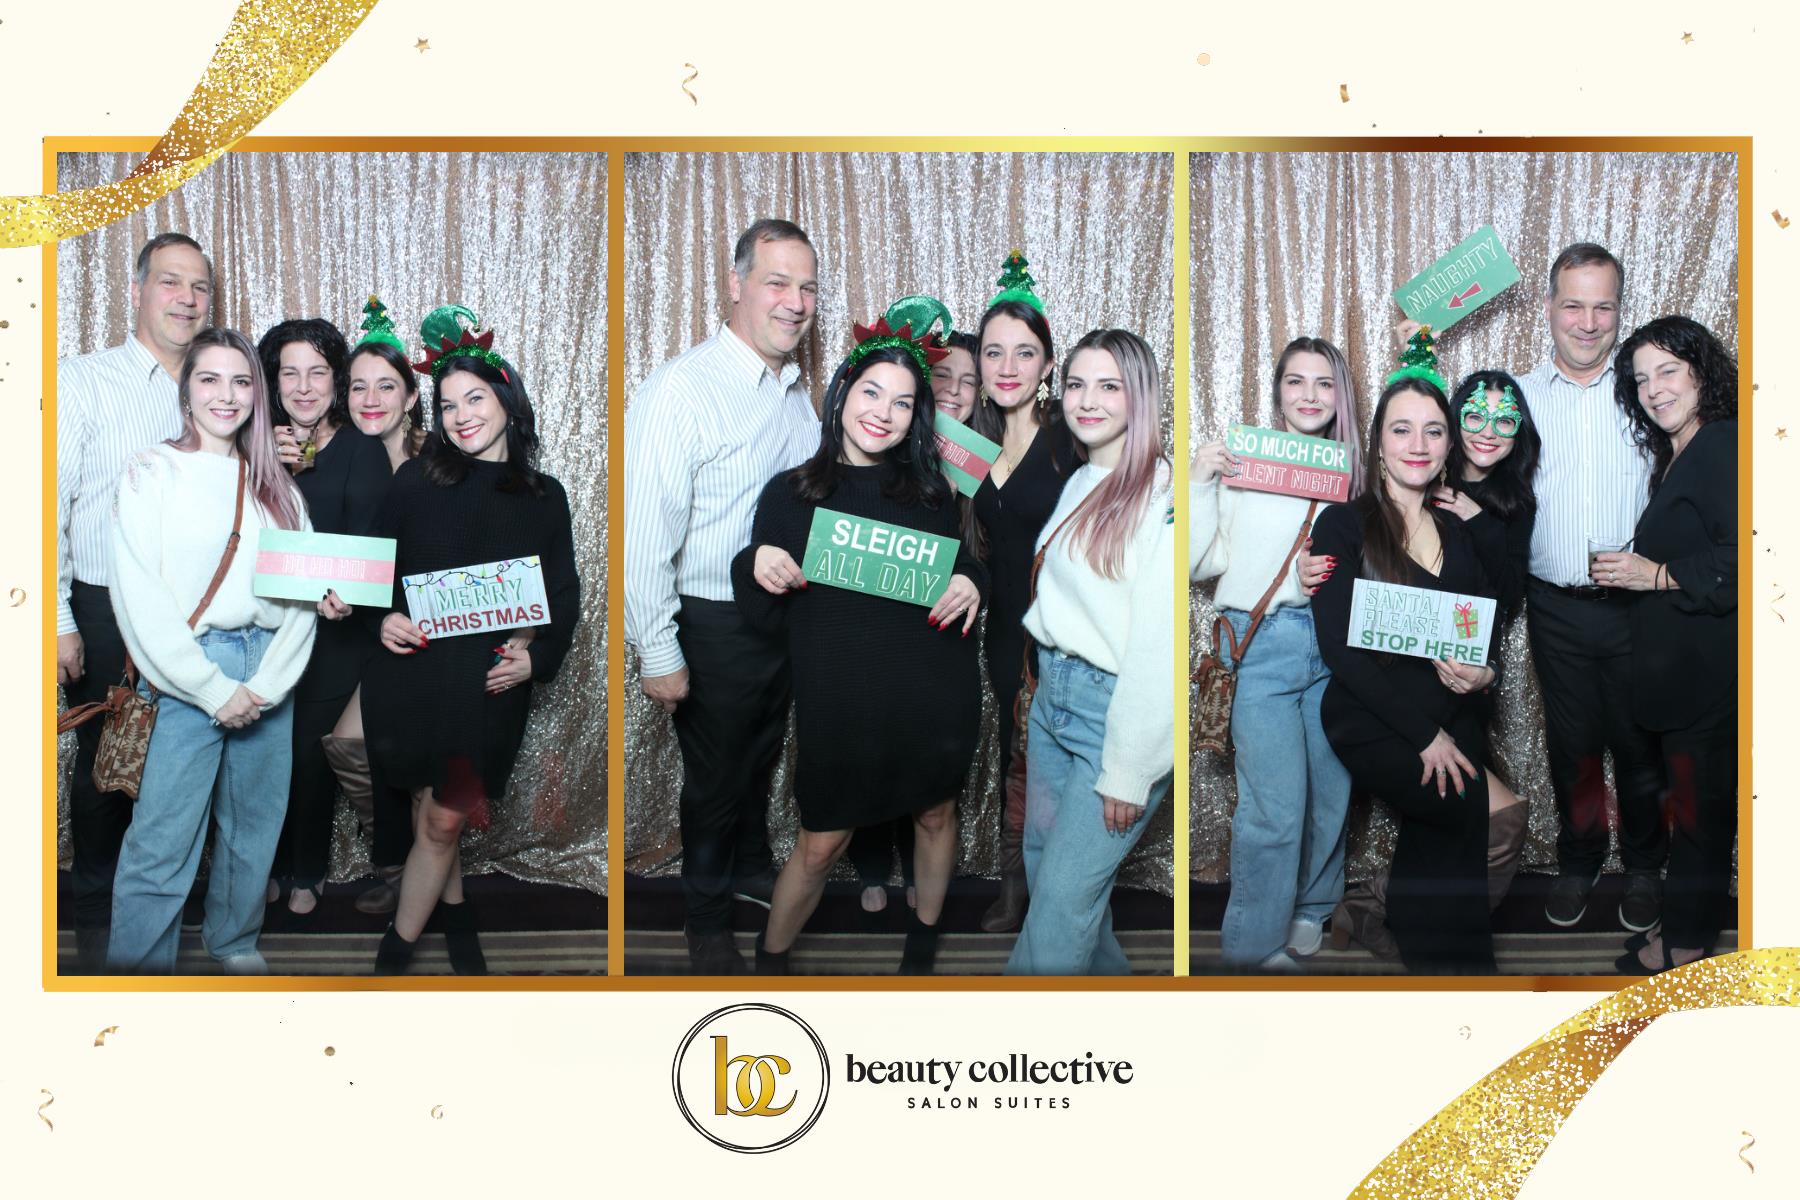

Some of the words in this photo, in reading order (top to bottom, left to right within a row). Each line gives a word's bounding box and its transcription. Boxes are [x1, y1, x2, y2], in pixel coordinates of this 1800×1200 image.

[1406, 237, 1497, 313] NAUGHTY
[1232, 432, 1257, 454] SO
[1261, 435, 1309, 462] MUCH
[1312, 444, 1345, 468] FOR
[1231, 461, 1287, 487] ILENT
[1290, 469, 1343, 496] NIGHT
[831, 518, 939, 566] SLEIGH
[813, 550, 864, 588] ALL
[875, 562, 941, 603] DAY
[435, 579, 522, 612] MERRY
[418, 603, 545, 636] CHRISTMAS
[1362, 608, 1441, 637] PLEASE
[1360, 629, 1419, 652] STOP
[1425, 639, 1483, 662] HERE
